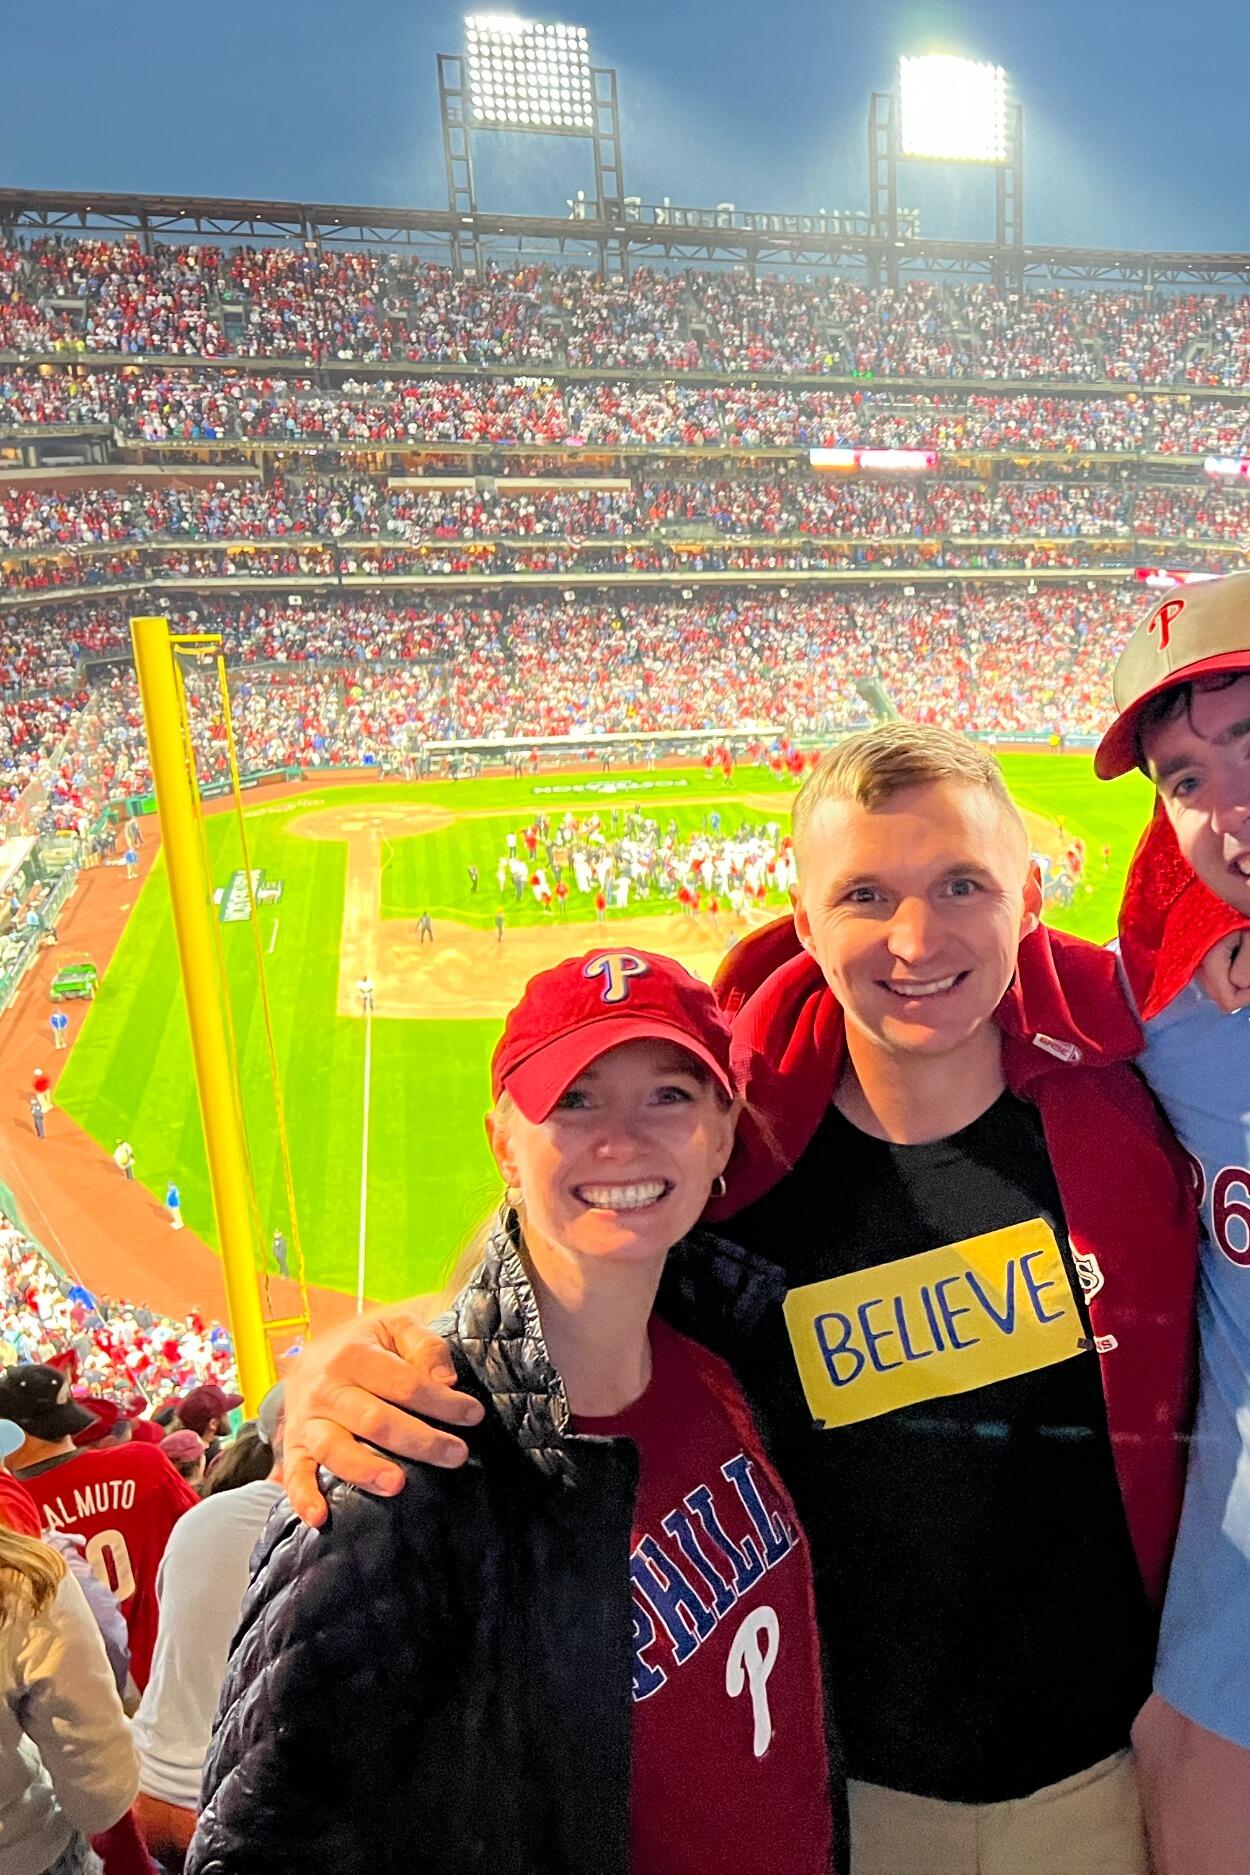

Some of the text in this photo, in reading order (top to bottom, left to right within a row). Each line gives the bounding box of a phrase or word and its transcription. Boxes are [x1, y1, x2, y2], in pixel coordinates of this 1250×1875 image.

[1147, 599, 1186, 653] P
[583, 952, 648, 1004] P
[813, 1250, 1066, 1387] BELIEVE
[726, 1605, 779, 1757] P
